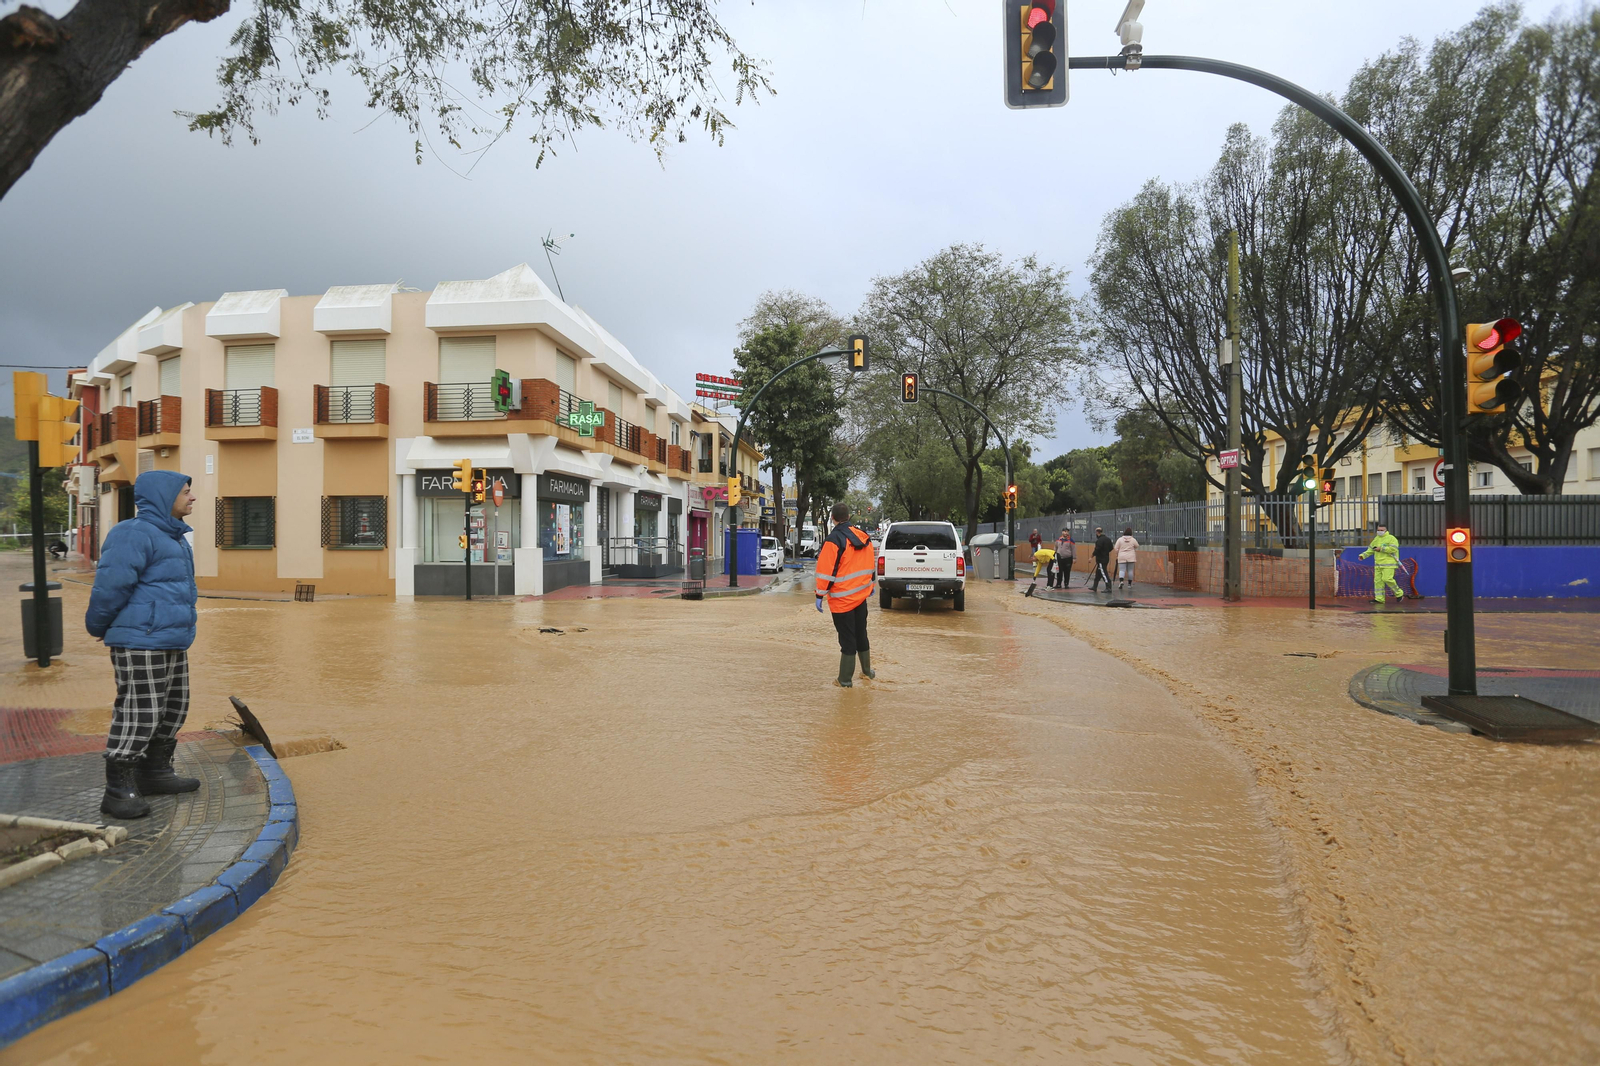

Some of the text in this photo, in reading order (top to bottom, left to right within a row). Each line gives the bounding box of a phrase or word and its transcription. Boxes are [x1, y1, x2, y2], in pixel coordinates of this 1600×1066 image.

[570, 414, 600, 425] RASA
[1221, 455, 1237, 466] OPTICA
[550, 479, 584, 496] FARMACIA
[475, 493, 483, 501] 30
[1324, 495, 1332, 503] 30
